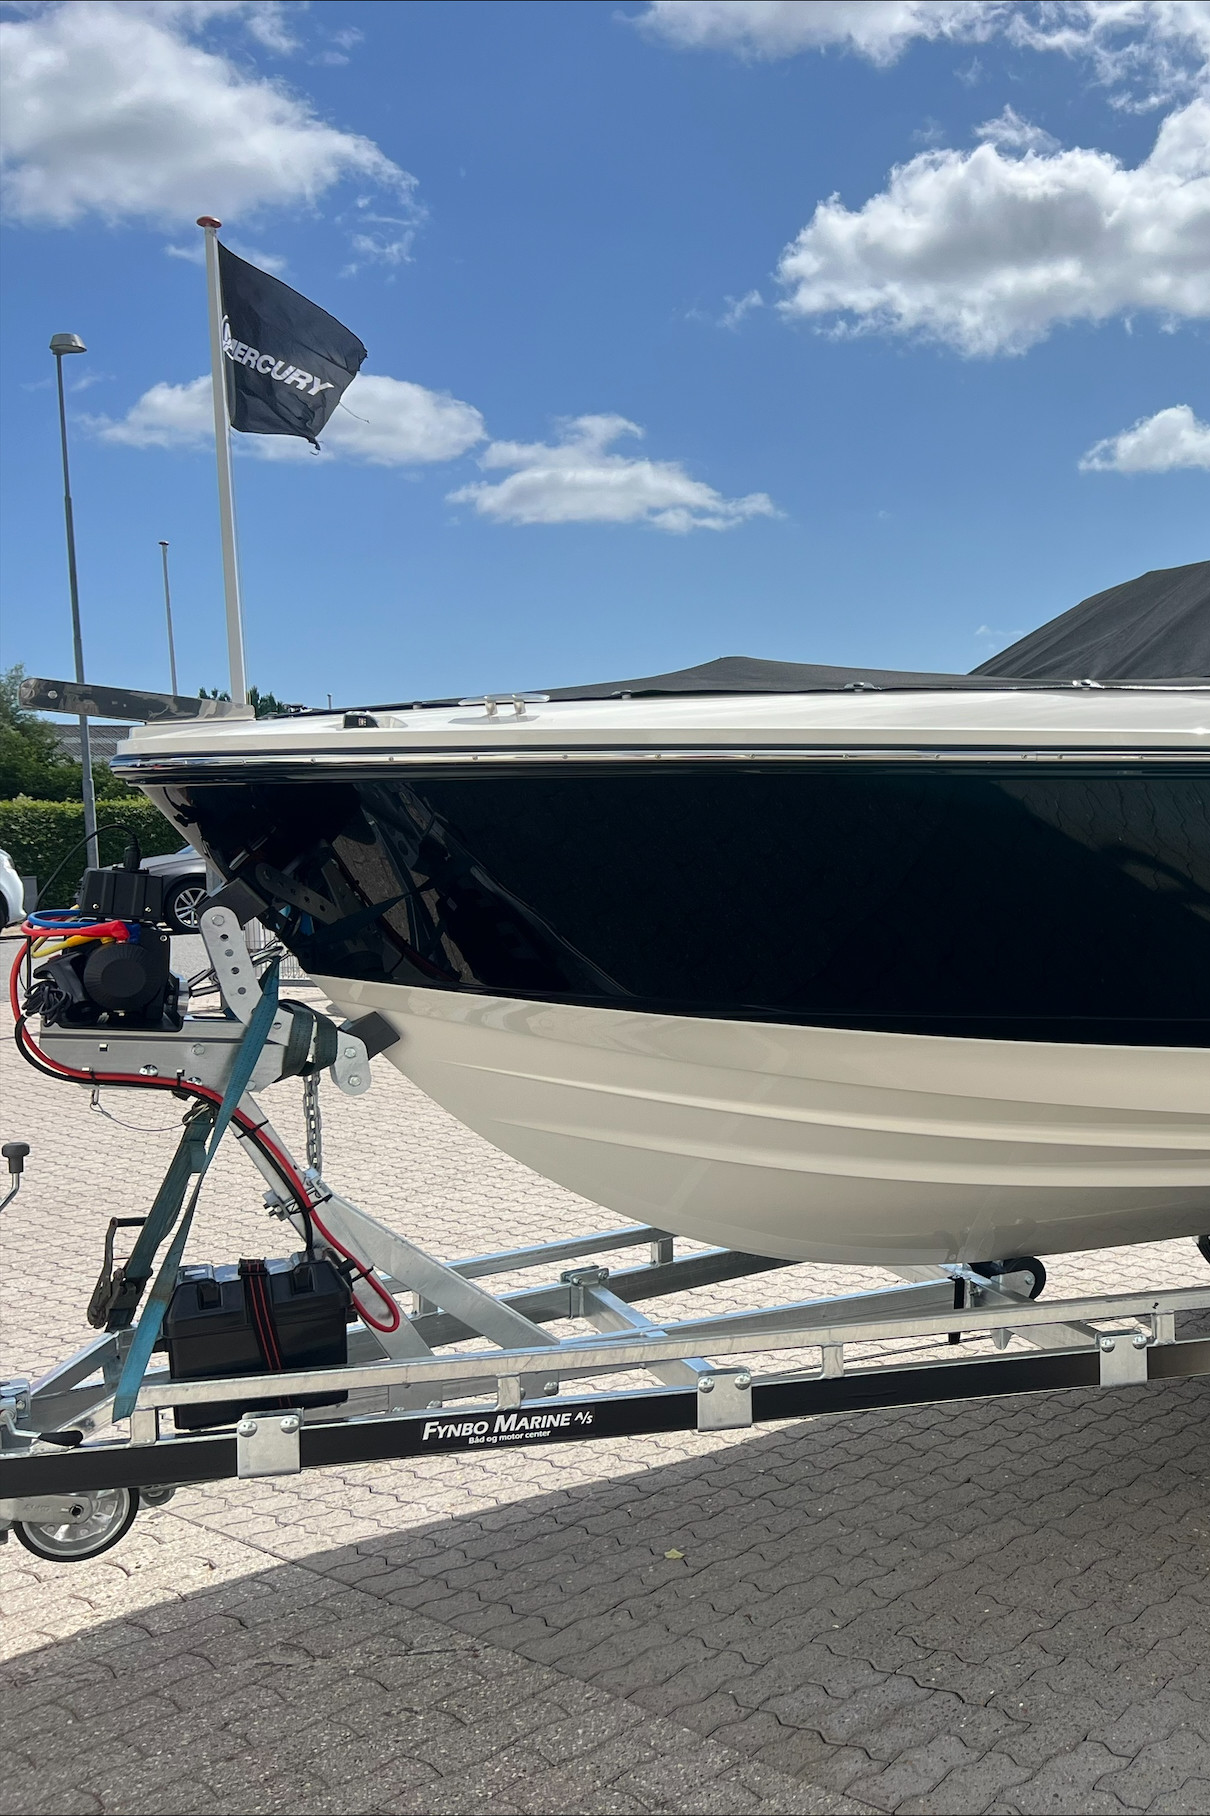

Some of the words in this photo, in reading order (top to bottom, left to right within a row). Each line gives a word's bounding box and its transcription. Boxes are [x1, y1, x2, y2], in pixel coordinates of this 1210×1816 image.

[493, 1413, 572, 1433] MARINE
[574, 1411, 593, 1425] A/S
[468, 1436, 485, 1444] Båd
[486, 1435, 498, 1444] og
[499, 1432, 524, 1441] motor
[525, 1430, 551, 1439] center
